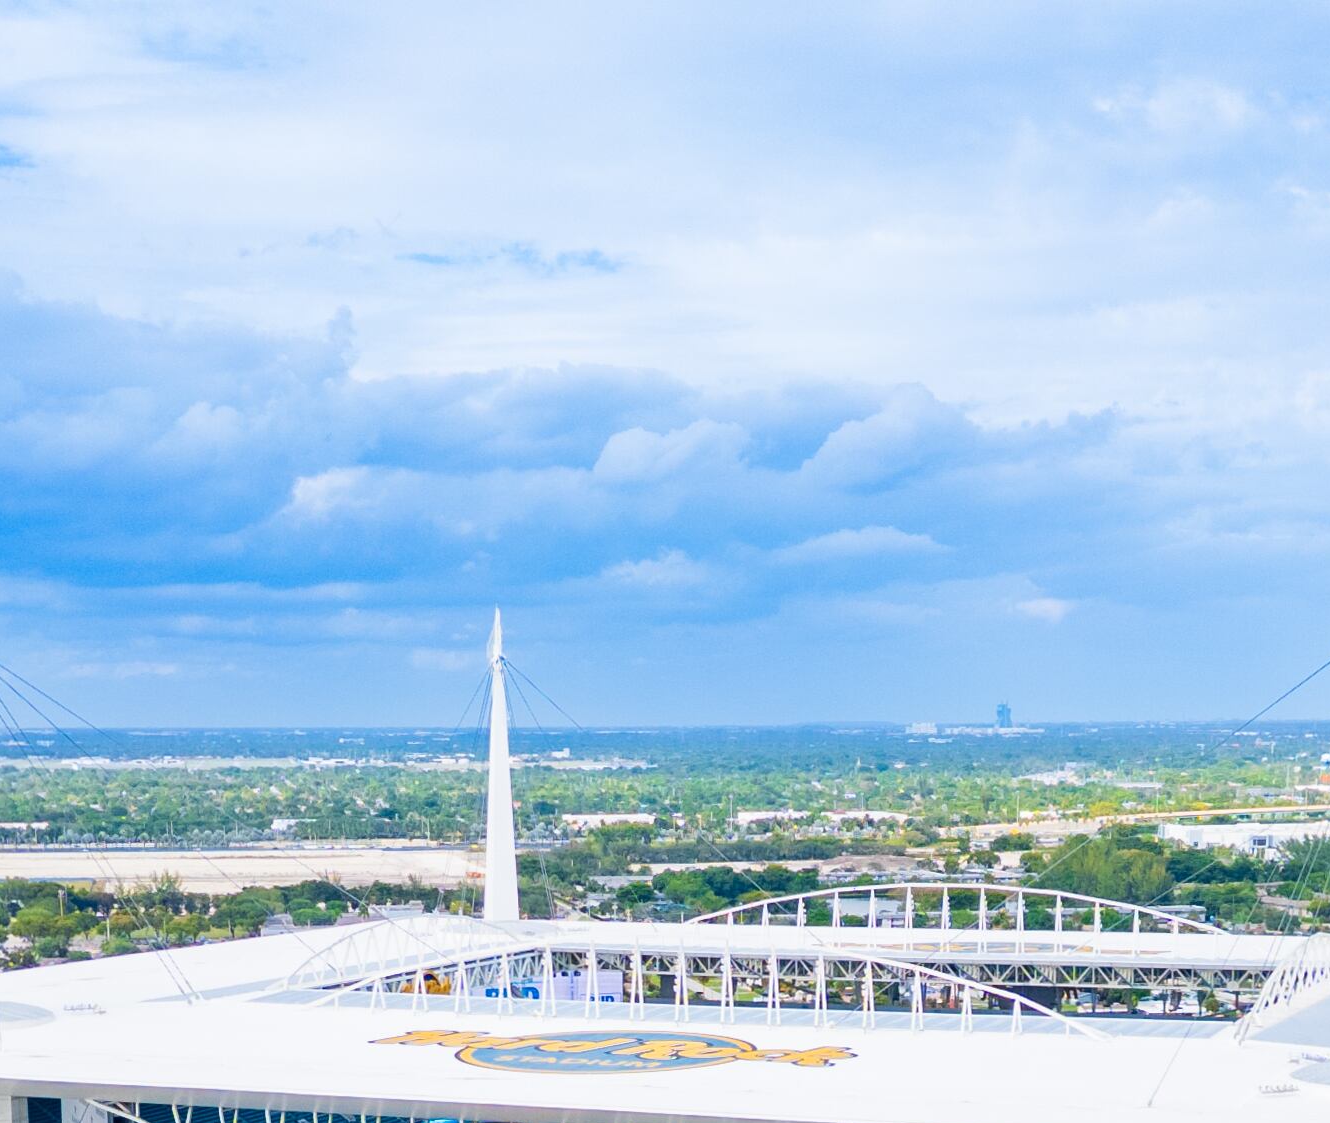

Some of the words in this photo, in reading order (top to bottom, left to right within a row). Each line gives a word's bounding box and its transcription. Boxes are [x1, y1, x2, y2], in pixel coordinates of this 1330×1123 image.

[368, 1030, 641, 1053] Hard
[608, 1038, 858, 1067] Rock
[495, 1054, 663, 1069] STADIUM
